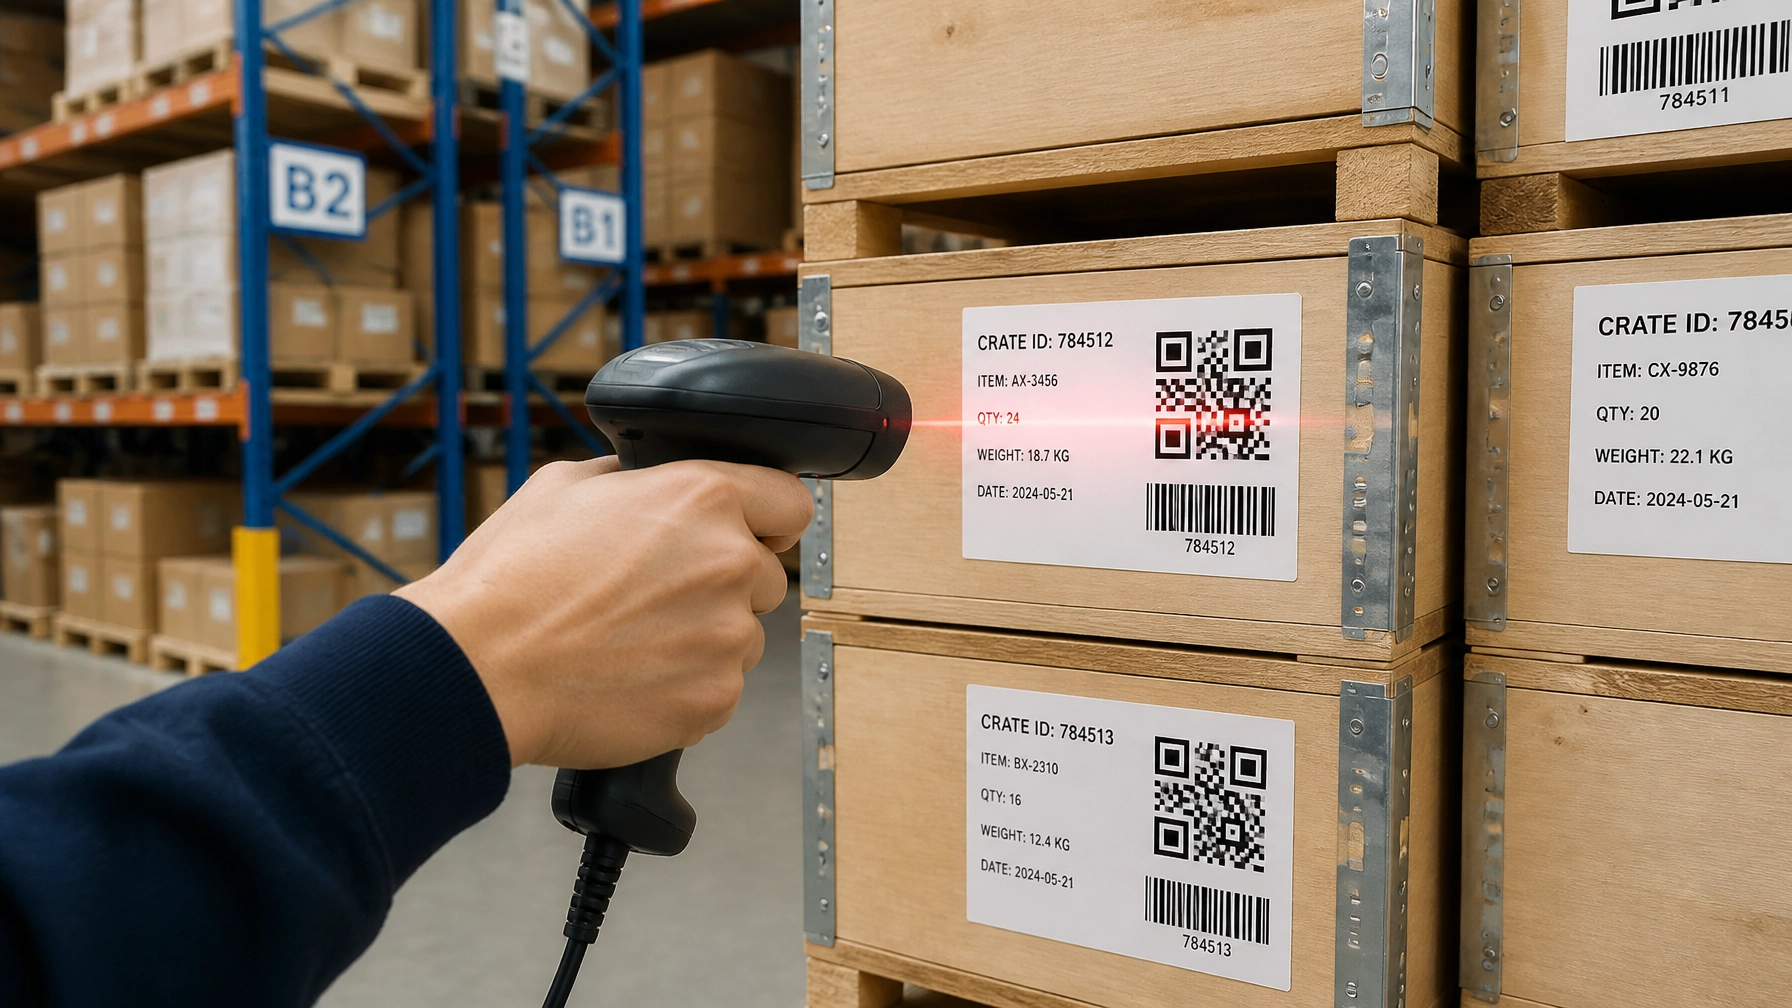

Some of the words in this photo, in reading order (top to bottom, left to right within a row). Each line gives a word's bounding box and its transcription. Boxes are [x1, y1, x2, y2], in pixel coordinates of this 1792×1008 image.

[1660, 87, 1729, 110] 784511
[288, 165, 351, 217] B2
[573, 206, 614, 249] B1
[1598, 313, 1678, 336] CRATE
[1686, 312, 1718, 333] ID:
[1727, 309, 1792, 331] 7845
[977, 334, 1027, 351] CRATE
[1032, 333, 1053, 350] ID:
[1057, 331, 1114, 349] 784512
[1597, 363, 1642, 379] ITEM:
[1648, 361, 1720, 378] CX-9876
[977, 374, 1008, 388] ITEM:
[1011, 373, 1058, 387] AX-3456
[977, 411, 1003, 426] QTY:
[1006, 411, 1020, 424] 24
[1596, 405, 1634, 423] QTY:
[1639, 405, 1660, 421] 20
[977, 448, 1024, 462] WEIGHT:
[1027, 449, 1050, 462] 18.7
[1053, 449, 1070, 463] KG
[1594, 448, 1665, 464] WEIGHT:
[1669, 448, 1702, 464] 22.1
[1709, 448, 1733, 465] KG
[977, 484, 1009, 499] DATE:
[1012, 486, 1074, 501] 2024-05-21
[1594, 490, 1641, 506] DATE:
[1646, 491, 1739, 509] 2024-05-21
[1184, 538, 1236, 556] 784512
[981, 713, 1030, 735] CRATE
[1035, 720, 1055, 738] ID:
[1059, 723, 1114, 746] 784513
[981, 751, 1011, 768] ITEM:
[1013, 756, 1059, 775] BX-2310
[980, 787, 1006, 804] QTY:
[1009, 793, 1022, 806] 16
[980, 823, 1026, 844] WEIGHT:
[1029, 832, 1051, 847] 12.4
[1054, 837, 1070, 852] KG
[981, 858, 1012, 876] DATE:
[1014, 865, 1074, 889] 2024-05-21
[1182, 934, 1232, 957] 784513
